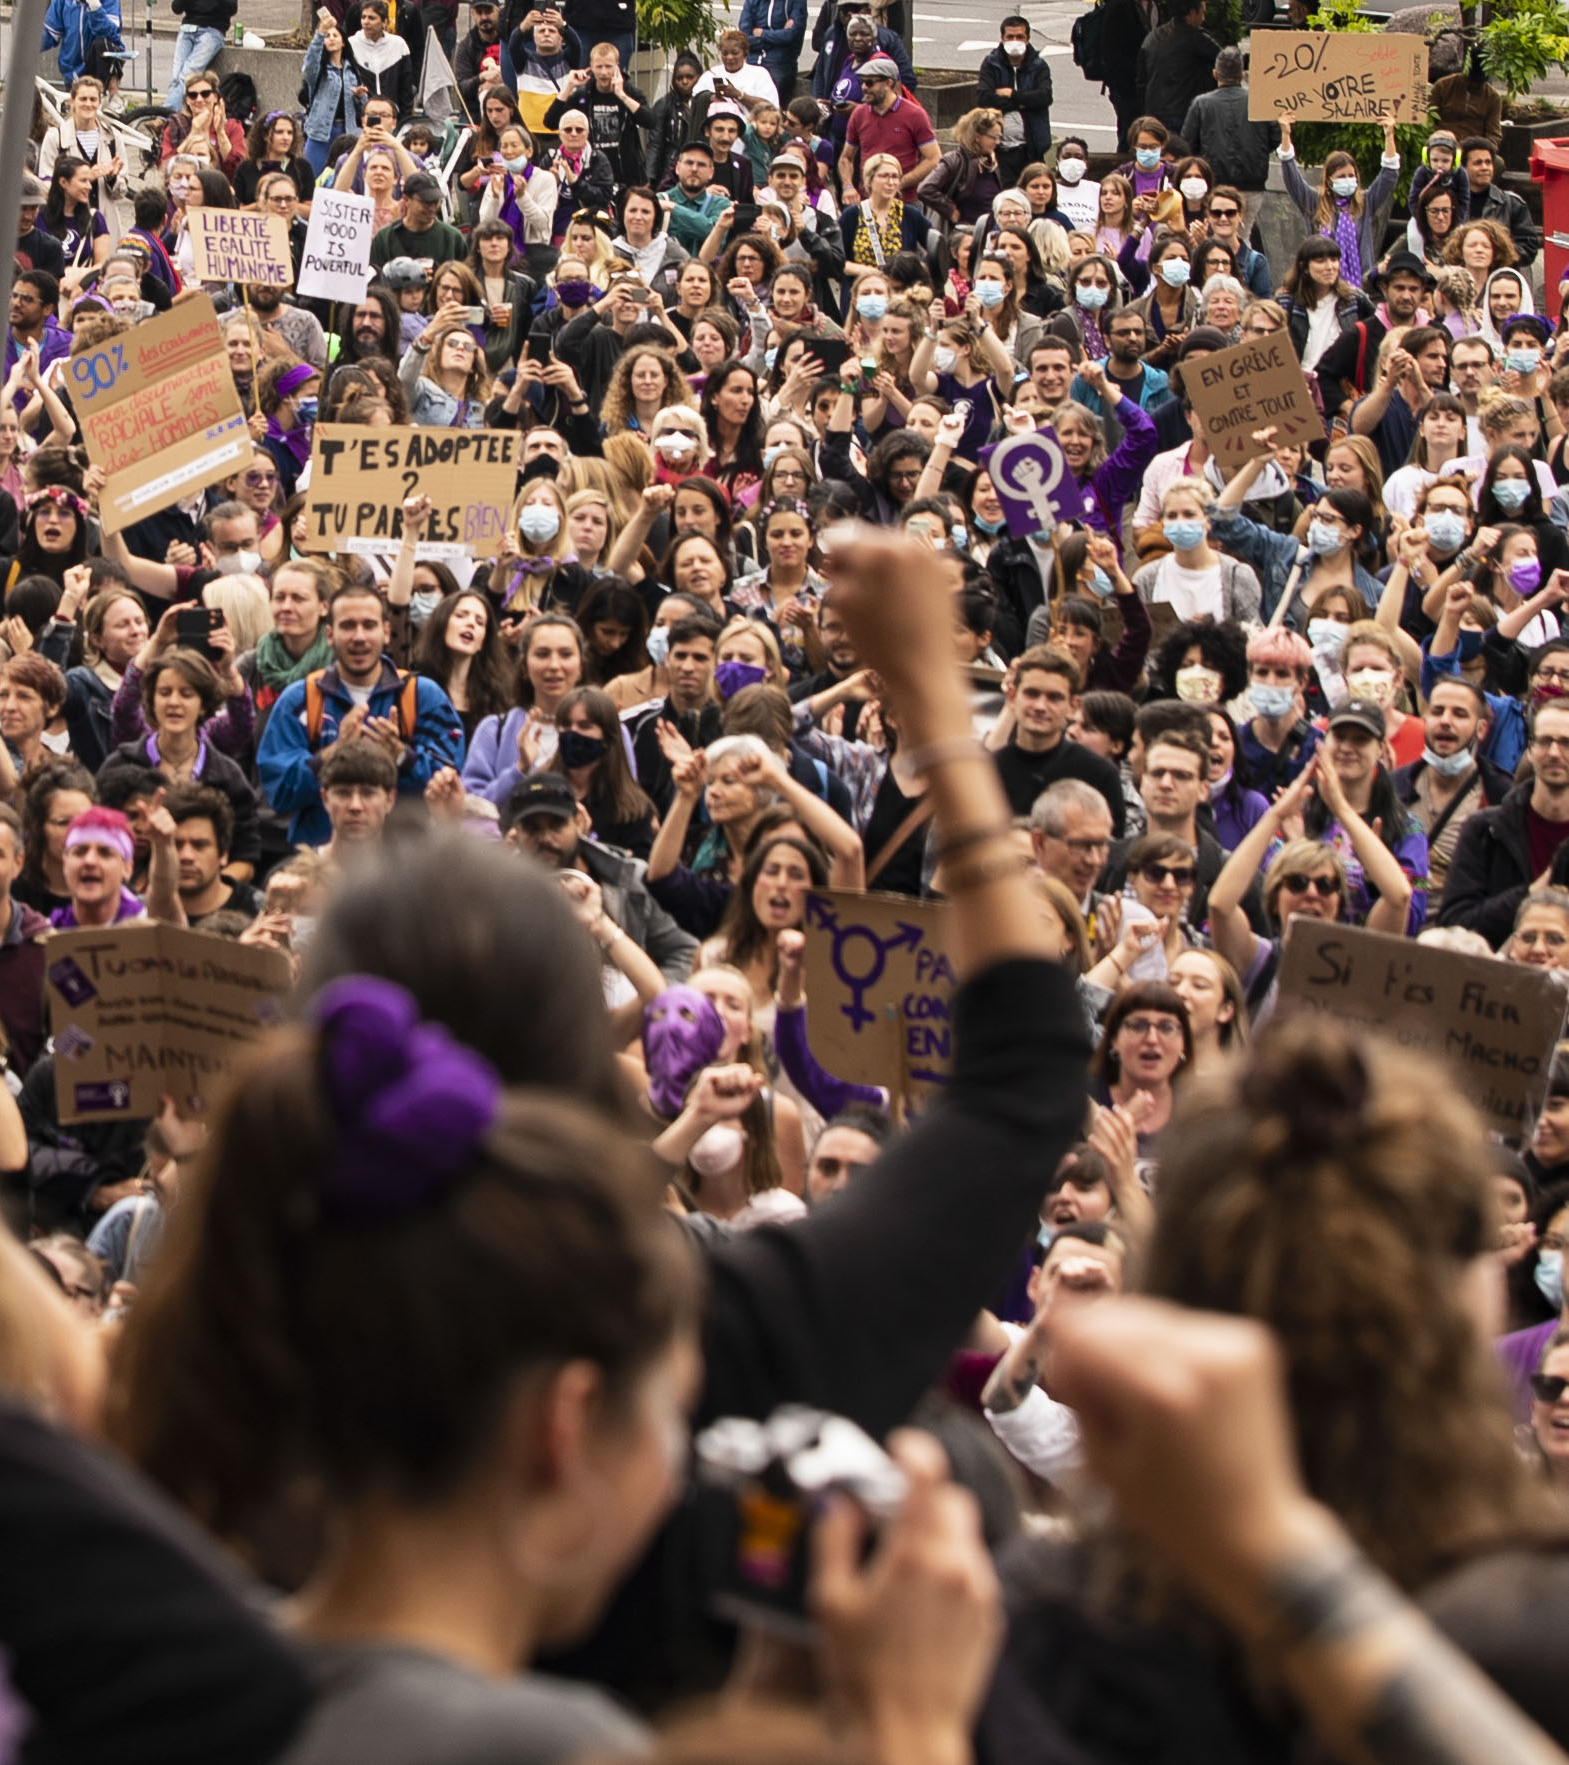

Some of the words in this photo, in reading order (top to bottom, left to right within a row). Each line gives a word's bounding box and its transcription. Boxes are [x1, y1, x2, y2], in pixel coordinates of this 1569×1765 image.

[1263, 33, 1332, 79] -20%
[1273, 91, 1313, 112] SUR
[1311, 73, 1376, 103] VOTRE
[202, 213, 272, 239] LIBERTÉ
[324, 222, 358, 241] HOOD
[206, 253, 288, 285] HUMANISME
[304, 254, 366, 278] POWERFUL
[328, 241, 347, 258] IS
[73, 342, 129, 399] 90%
[1200, 364, 1224, 388] EN
[1229, 346, 1285, 379] GRÈVE
[1233, 383, 1251, 400] ET
[98, 395, 177, 456] RACIALE
[149, 401, 220, 454] HOMMES
[1208, 404, 1258, 434] CONTRE
[1257, 391, 1297, 418] TOUT
[318, 438, 401, 476] T'ES
[405, 434, 515, 468] ADOPTEE
[312, 502, 348, 537] TU
[462, 500, 511, 542] BIEN
[915, 948, 958, 986] PA
[902, 993, 951, 1022] CON
